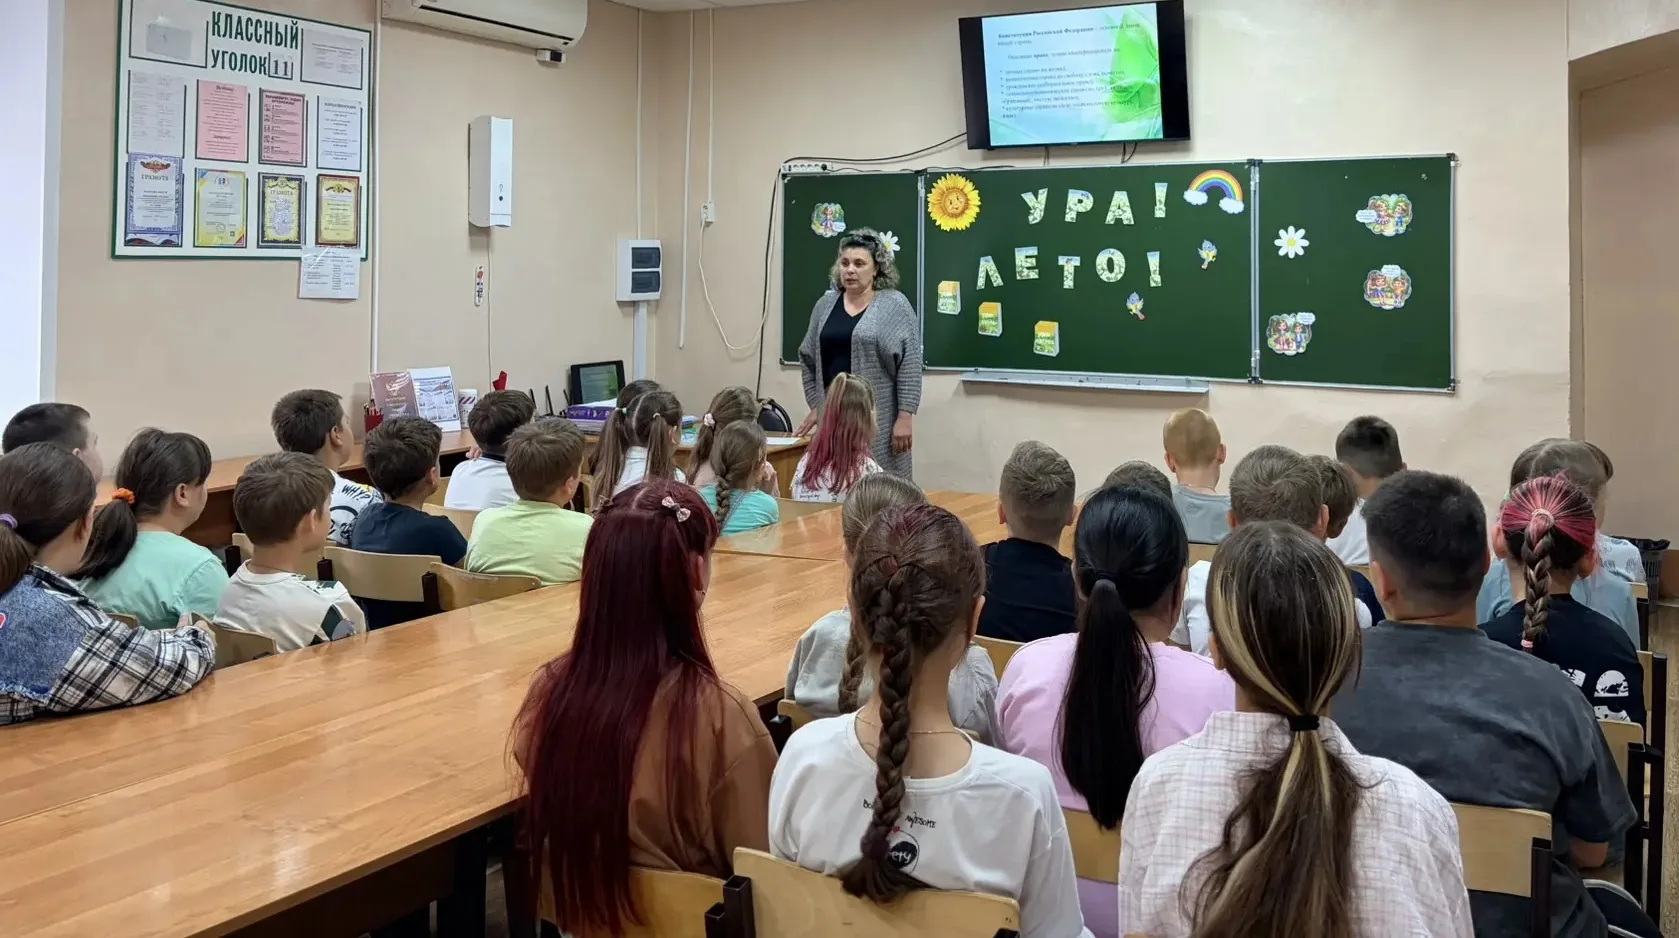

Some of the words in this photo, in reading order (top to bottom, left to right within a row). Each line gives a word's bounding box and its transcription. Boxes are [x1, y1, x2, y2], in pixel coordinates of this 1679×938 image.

[211, 11, 299, 50] КЛАССНЫЙ
[211, 49, 267, 76] УГОЛОК
[273, 59, 289, 76] 11
[141, 173, 169, 181] ГРАМОТА
[1021, 182, 1168, 225] УРА!
[976, 246, 1161, 290] ЛЕТО!
